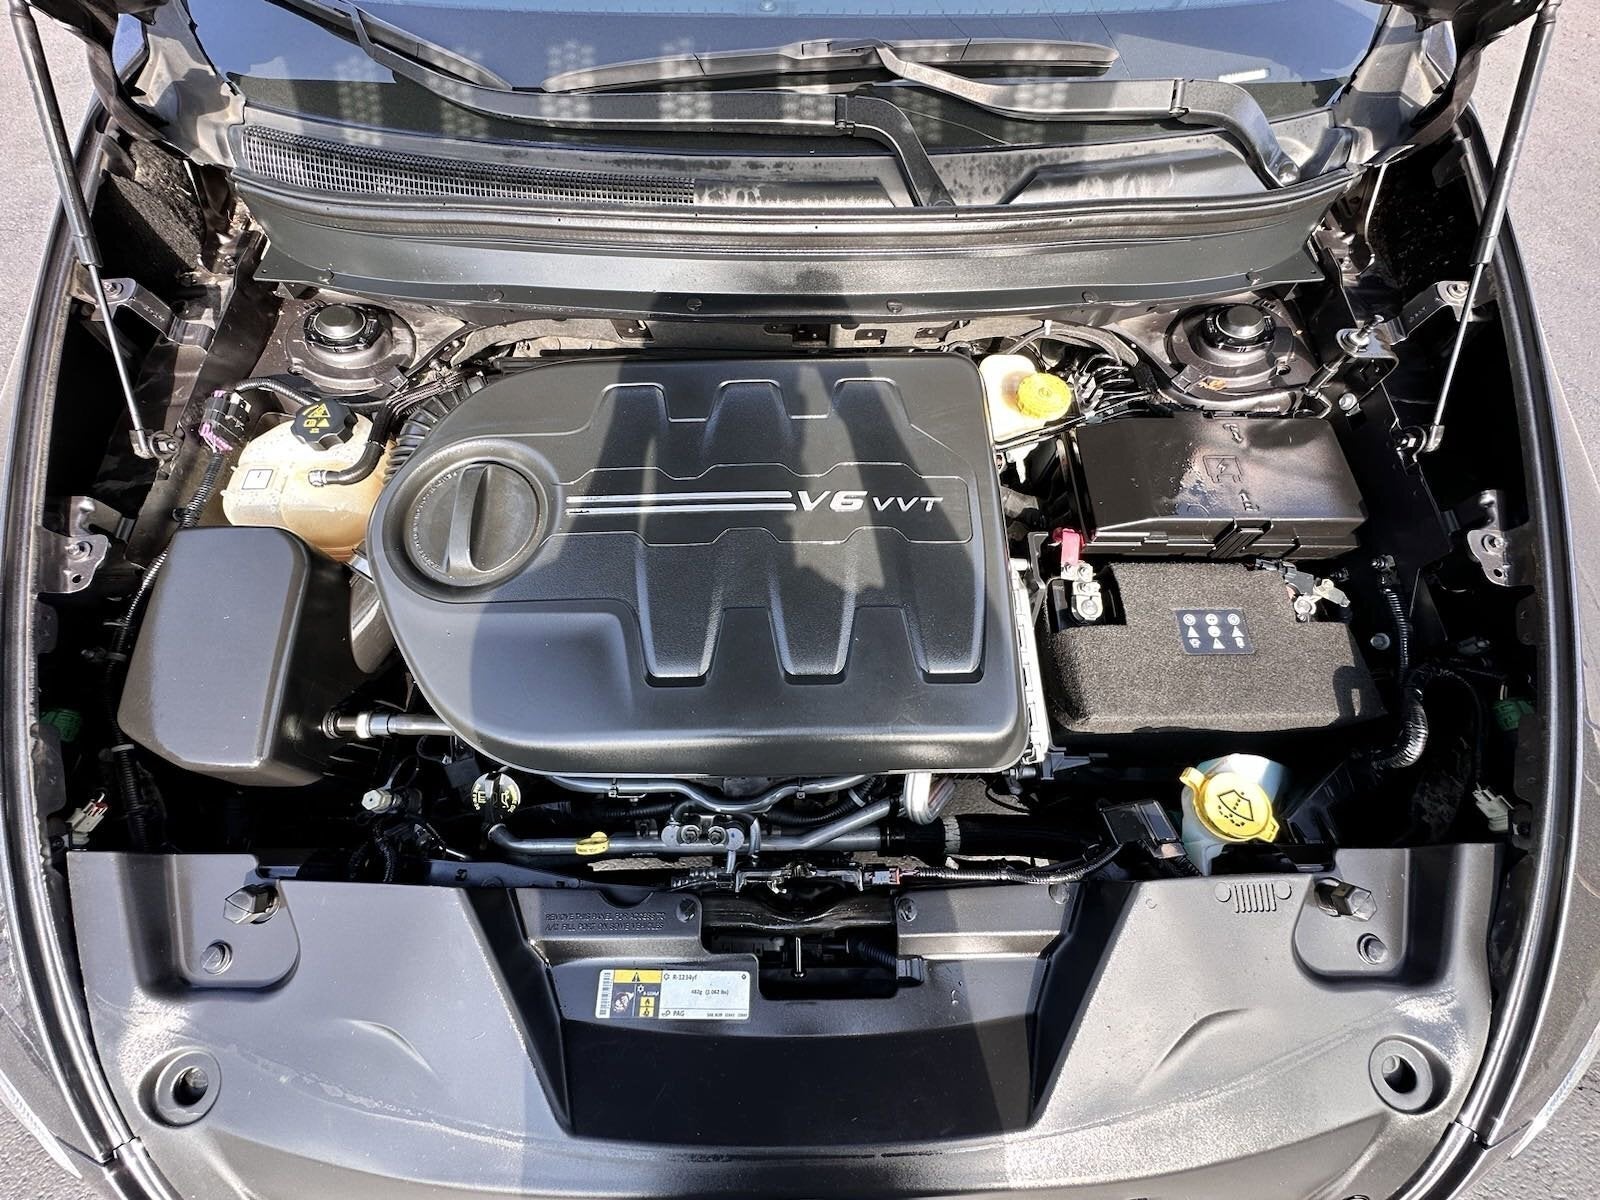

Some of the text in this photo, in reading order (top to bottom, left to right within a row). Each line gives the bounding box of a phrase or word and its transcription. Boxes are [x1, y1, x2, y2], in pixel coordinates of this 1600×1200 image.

[797, 490, 943, 512] V6 VVT
[673, 974, 697, 982] R-1234yf
